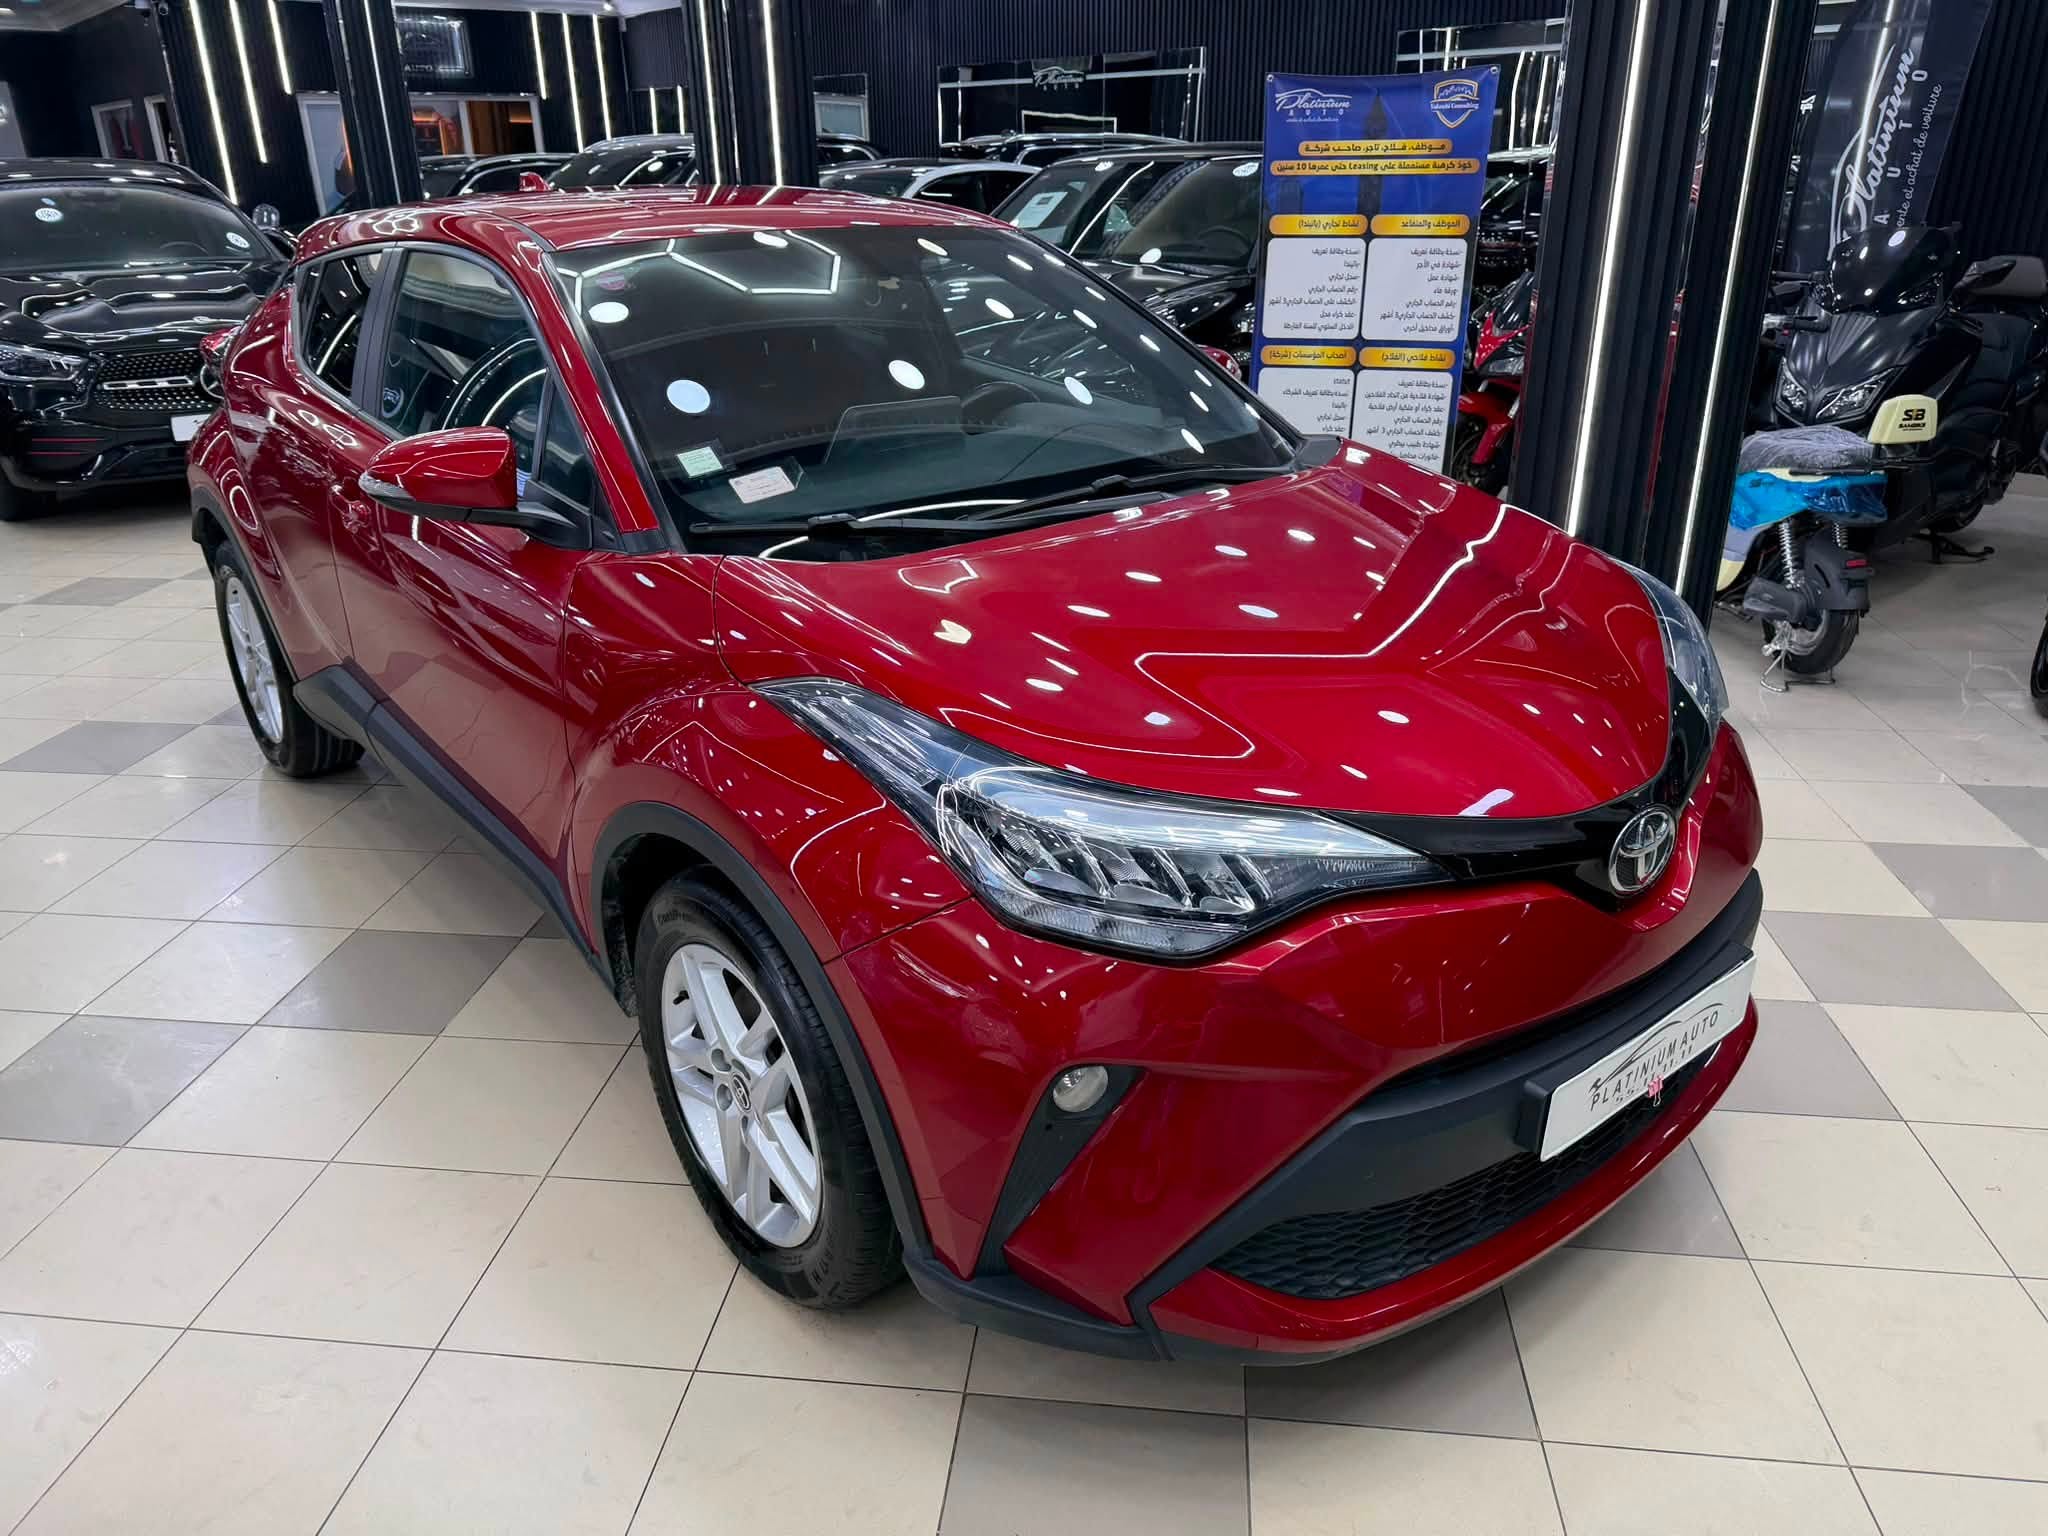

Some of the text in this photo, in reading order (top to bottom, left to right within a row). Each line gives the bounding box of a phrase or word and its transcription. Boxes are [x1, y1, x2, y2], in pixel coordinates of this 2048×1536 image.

[1296, 162, 1307, 170] 10
[1349, 162, 1378, 171] Leasing
[1896, 83, 1942, 227] ente et achat de voiture
[1591, 1039, 1677, 1111] PLATINIUM
[1680, 1010, 1719, 1049] AUTO
